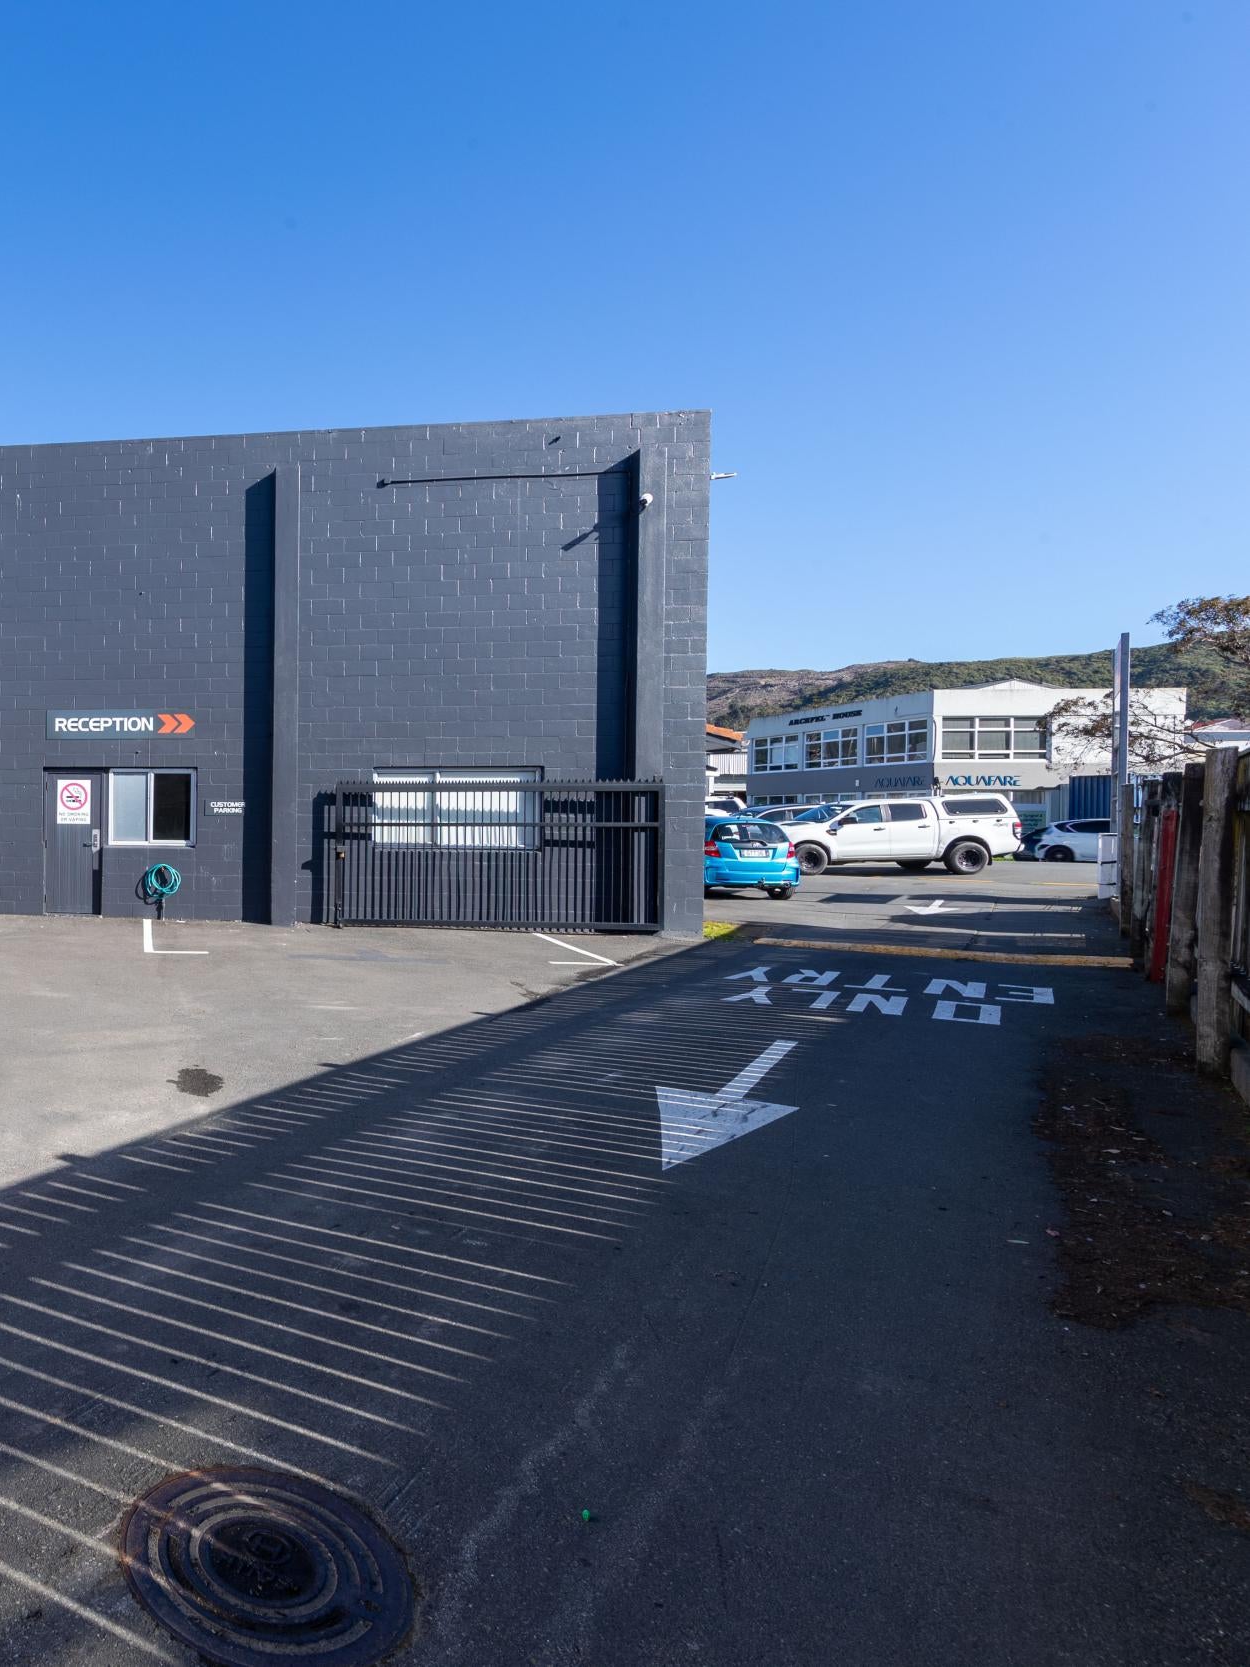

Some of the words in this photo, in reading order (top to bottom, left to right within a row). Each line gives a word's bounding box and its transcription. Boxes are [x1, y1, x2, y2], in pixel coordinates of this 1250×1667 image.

[54, 716, 154, 732] RECEPTION
[945, 775, 1022, 787] AQUAFARE
[722, 966, 1055, 1005] ENTRY
[720, 986, 1002, 1026] ONLY
